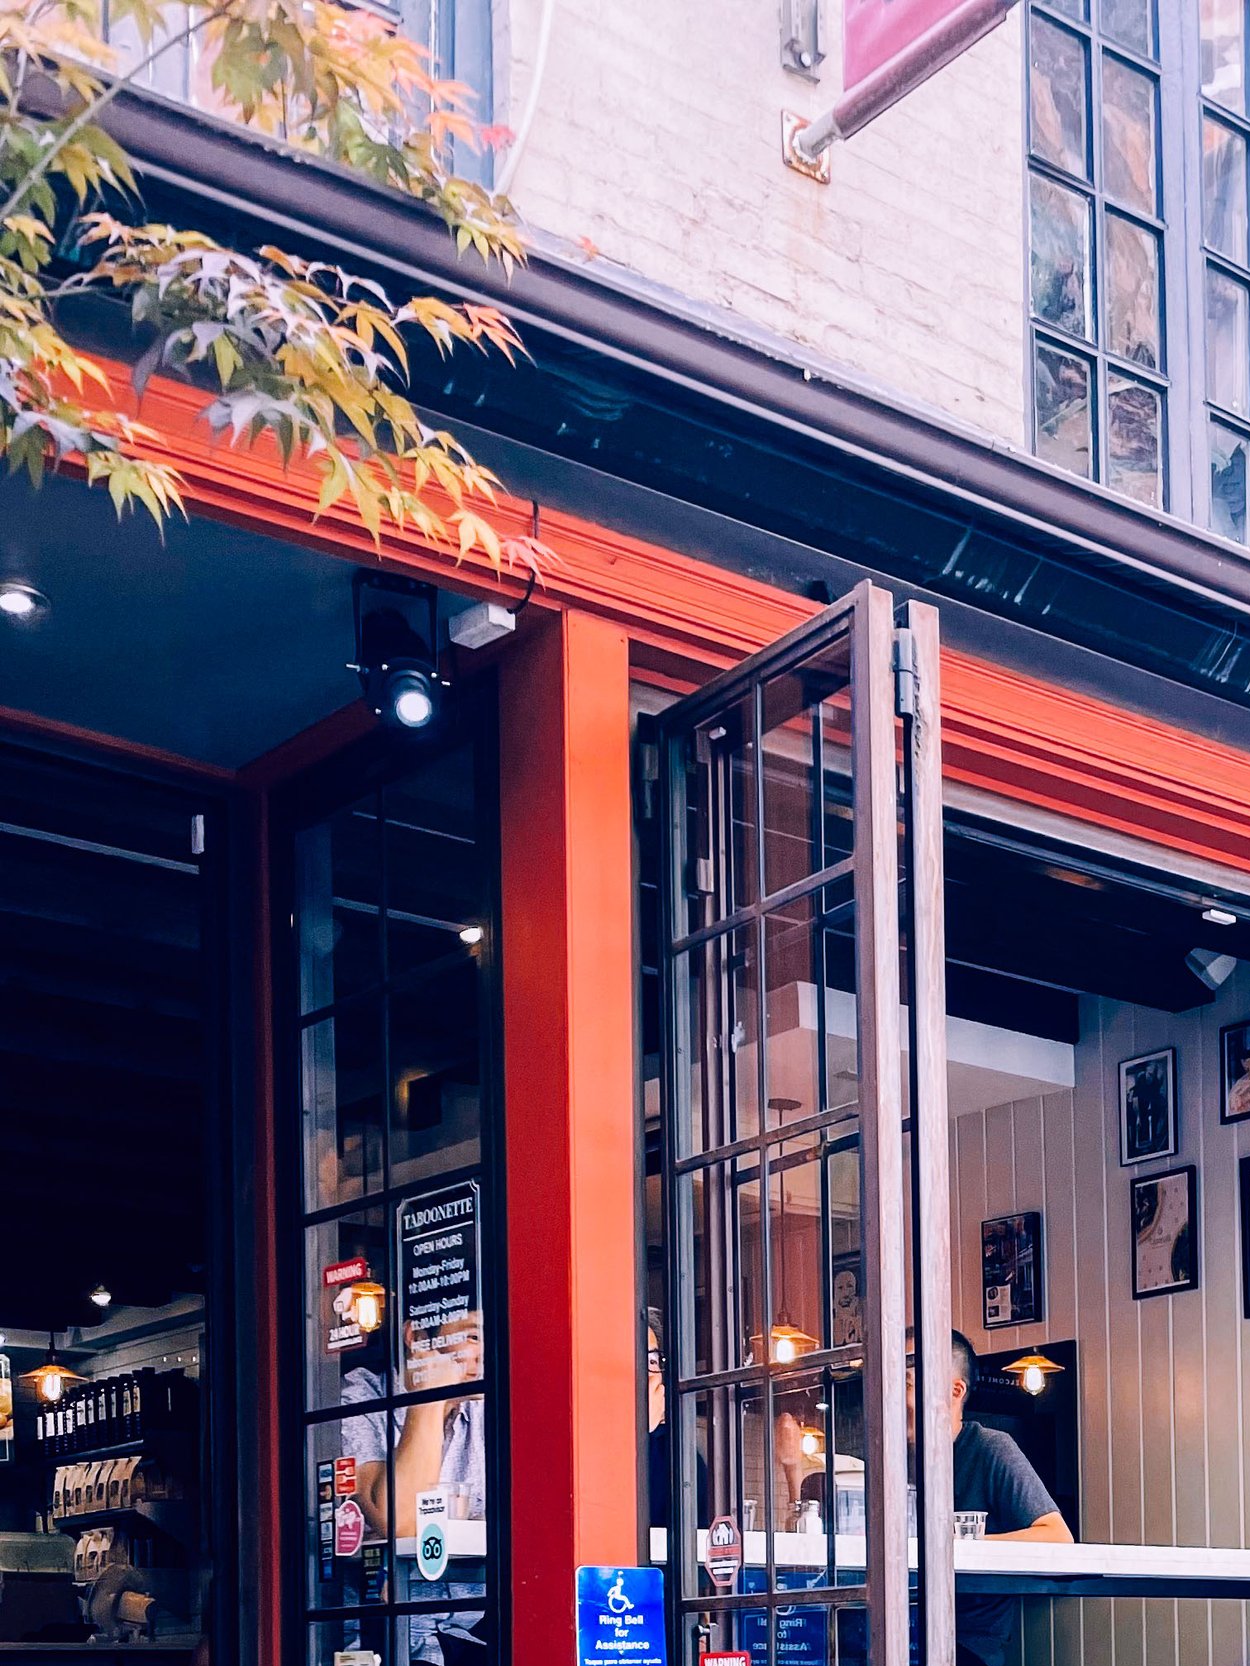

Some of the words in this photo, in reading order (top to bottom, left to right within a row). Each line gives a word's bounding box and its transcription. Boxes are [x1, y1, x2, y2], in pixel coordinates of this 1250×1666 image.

[403, 1196, 473, 1230] TABOONETTE
[413, 1240, 434, 1256] OPEN
[435, 1233, 463, 1250] HOURS
[326, 1262, 363, 1284] WARNING
[599, 1615, 622, 1627] Ring
[624, 1615, 644, 1625] Bell
[615, 1628, 629, 1637] for
[595, 1640, 650, 1650] Assistance
